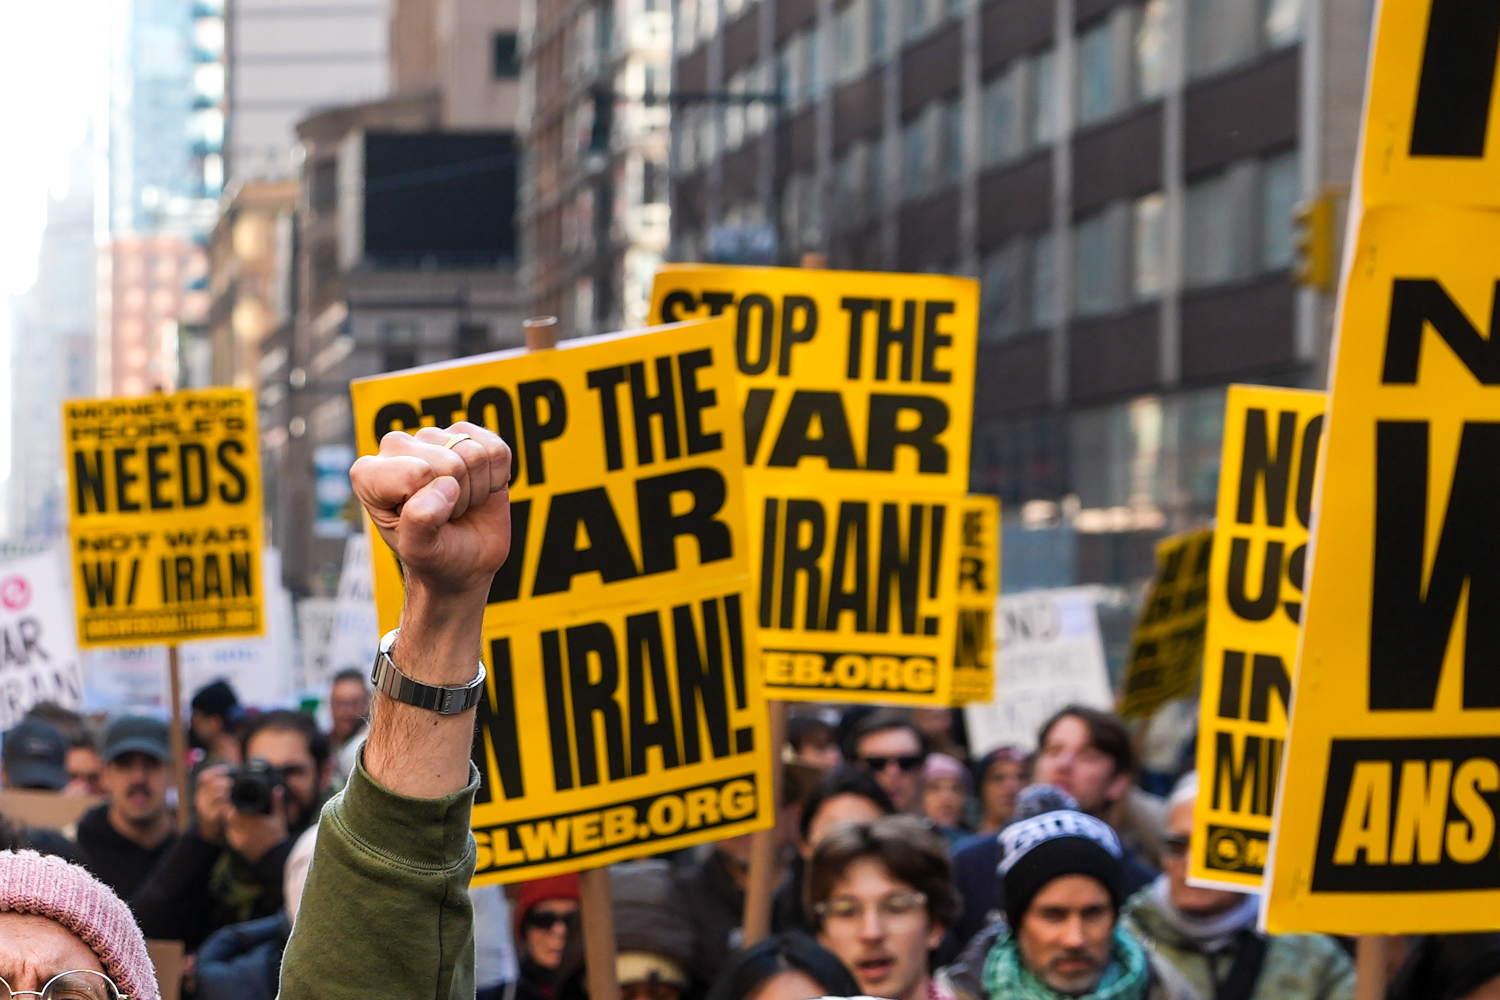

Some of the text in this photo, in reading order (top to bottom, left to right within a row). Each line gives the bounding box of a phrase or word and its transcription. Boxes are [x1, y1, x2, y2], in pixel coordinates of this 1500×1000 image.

[841, 296, 955, 384] THE
[70, 402, 173, 419] MONEY
[587, 347, 723, 471] THE
[74, 440, 248, 515] NEEDS
[78, 524, 249, 551] NOT WAR
[759, 496, 947, 637] IRAN!
[81, 551, 253, 608] W/ IRAN
[540, 592, 755, 793] IRAN!
[765, 652, 938, 691] EB.ORG
